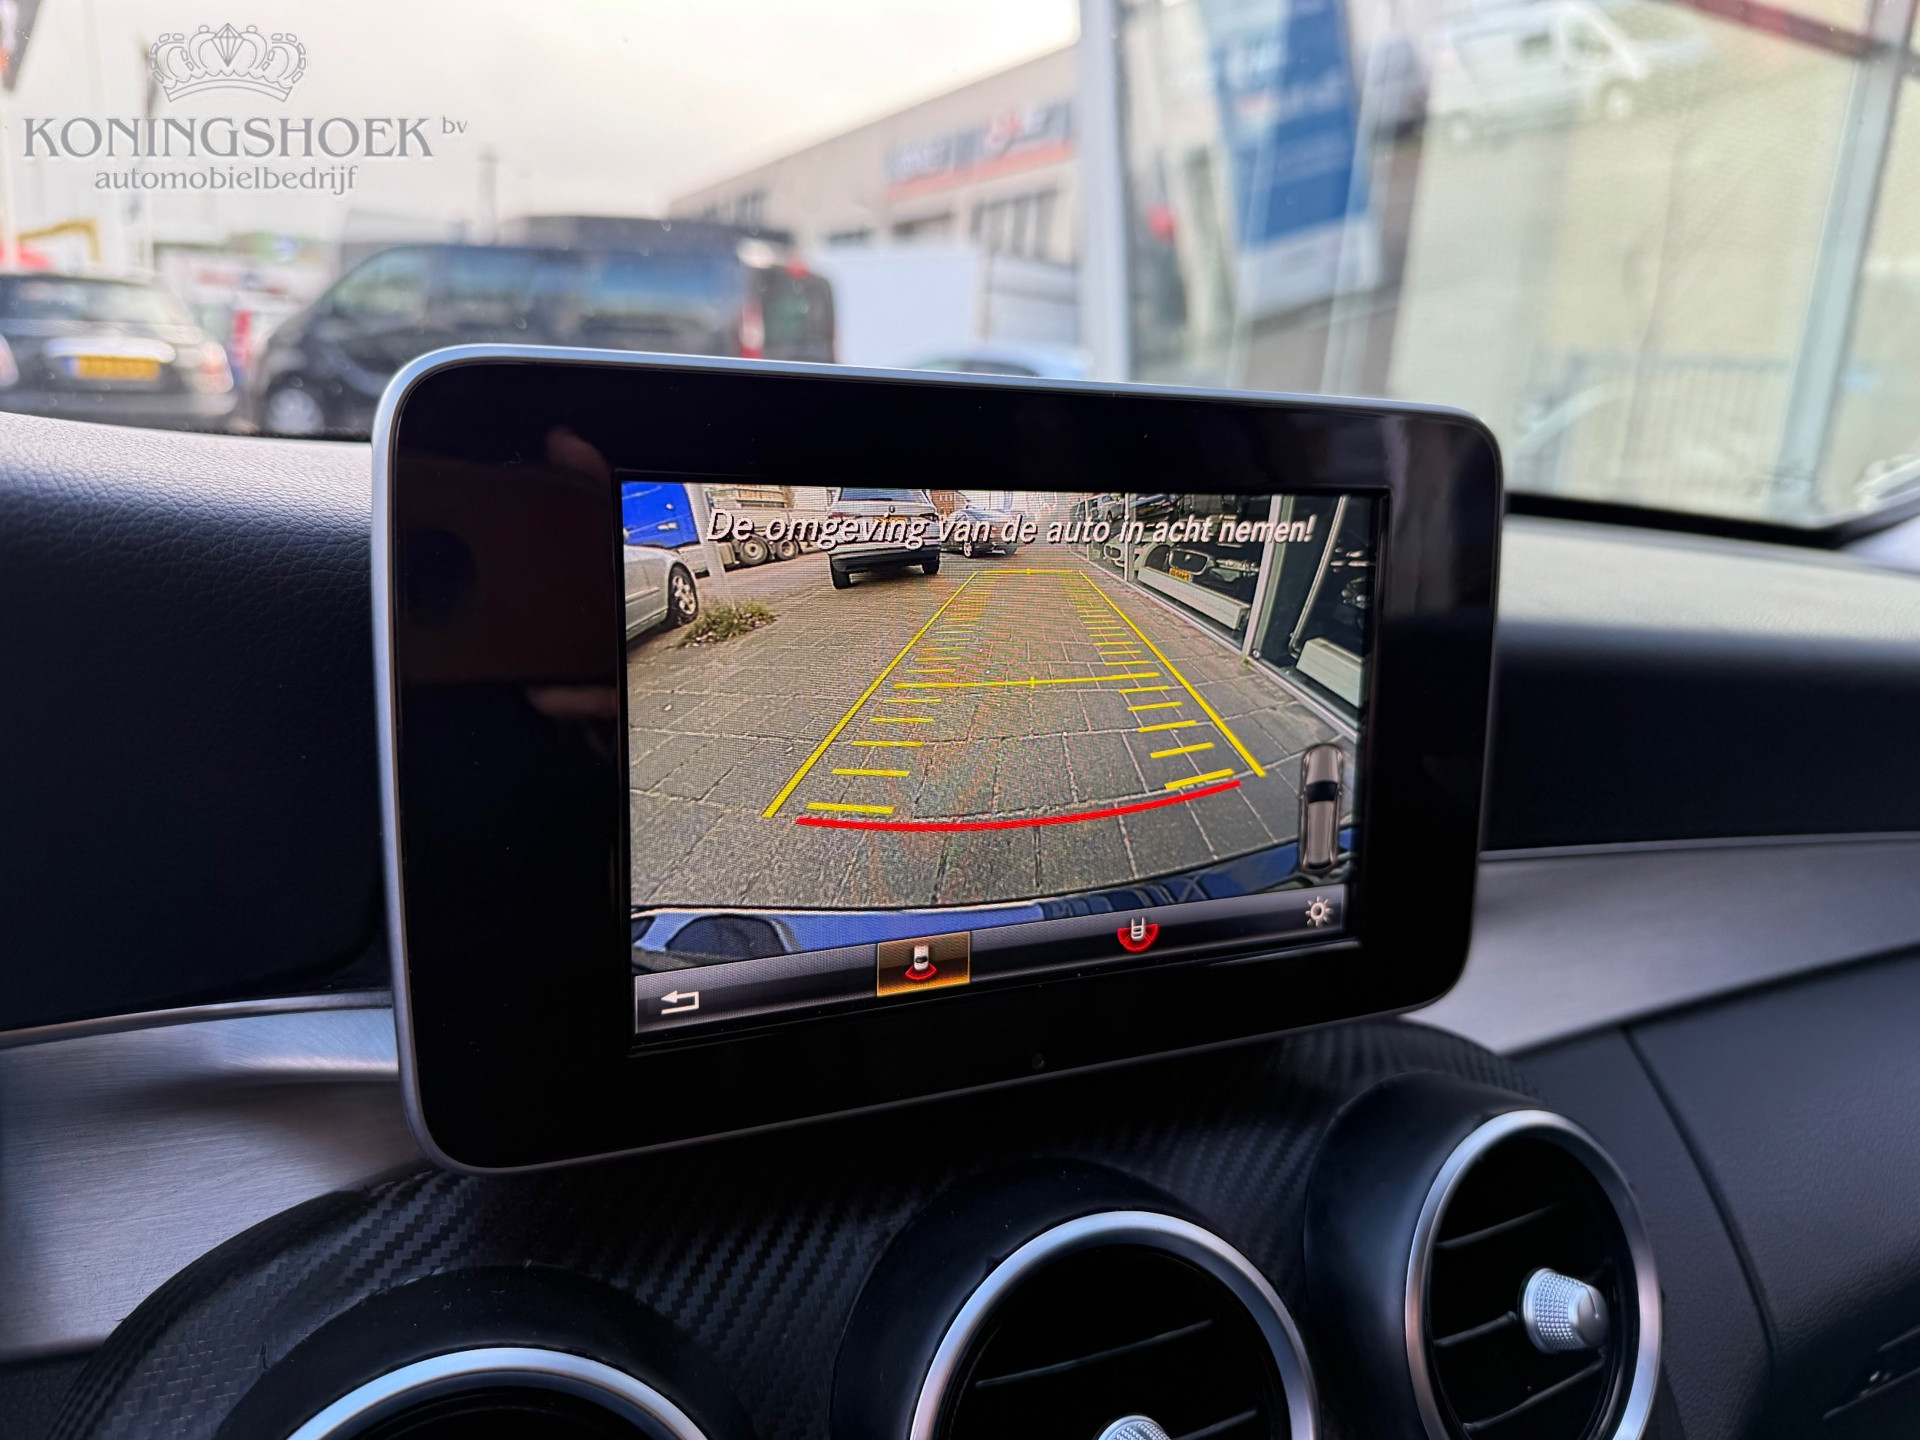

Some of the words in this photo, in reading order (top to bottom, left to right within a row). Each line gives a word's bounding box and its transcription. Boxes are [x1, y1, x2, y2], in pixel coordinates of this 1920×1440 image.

[706, 508, 755, 542] De
[765, 513, 926, 550] omgeving
[938, 520, 991, 543] van
[1000, 514, 1037, 543] de
[1046, 517, 1110, 543] auto
[1119, 516, 1143, 543] in
[1152, 514, 1210, 543] acht
[1218, 514, 1317, 543] nemen!
